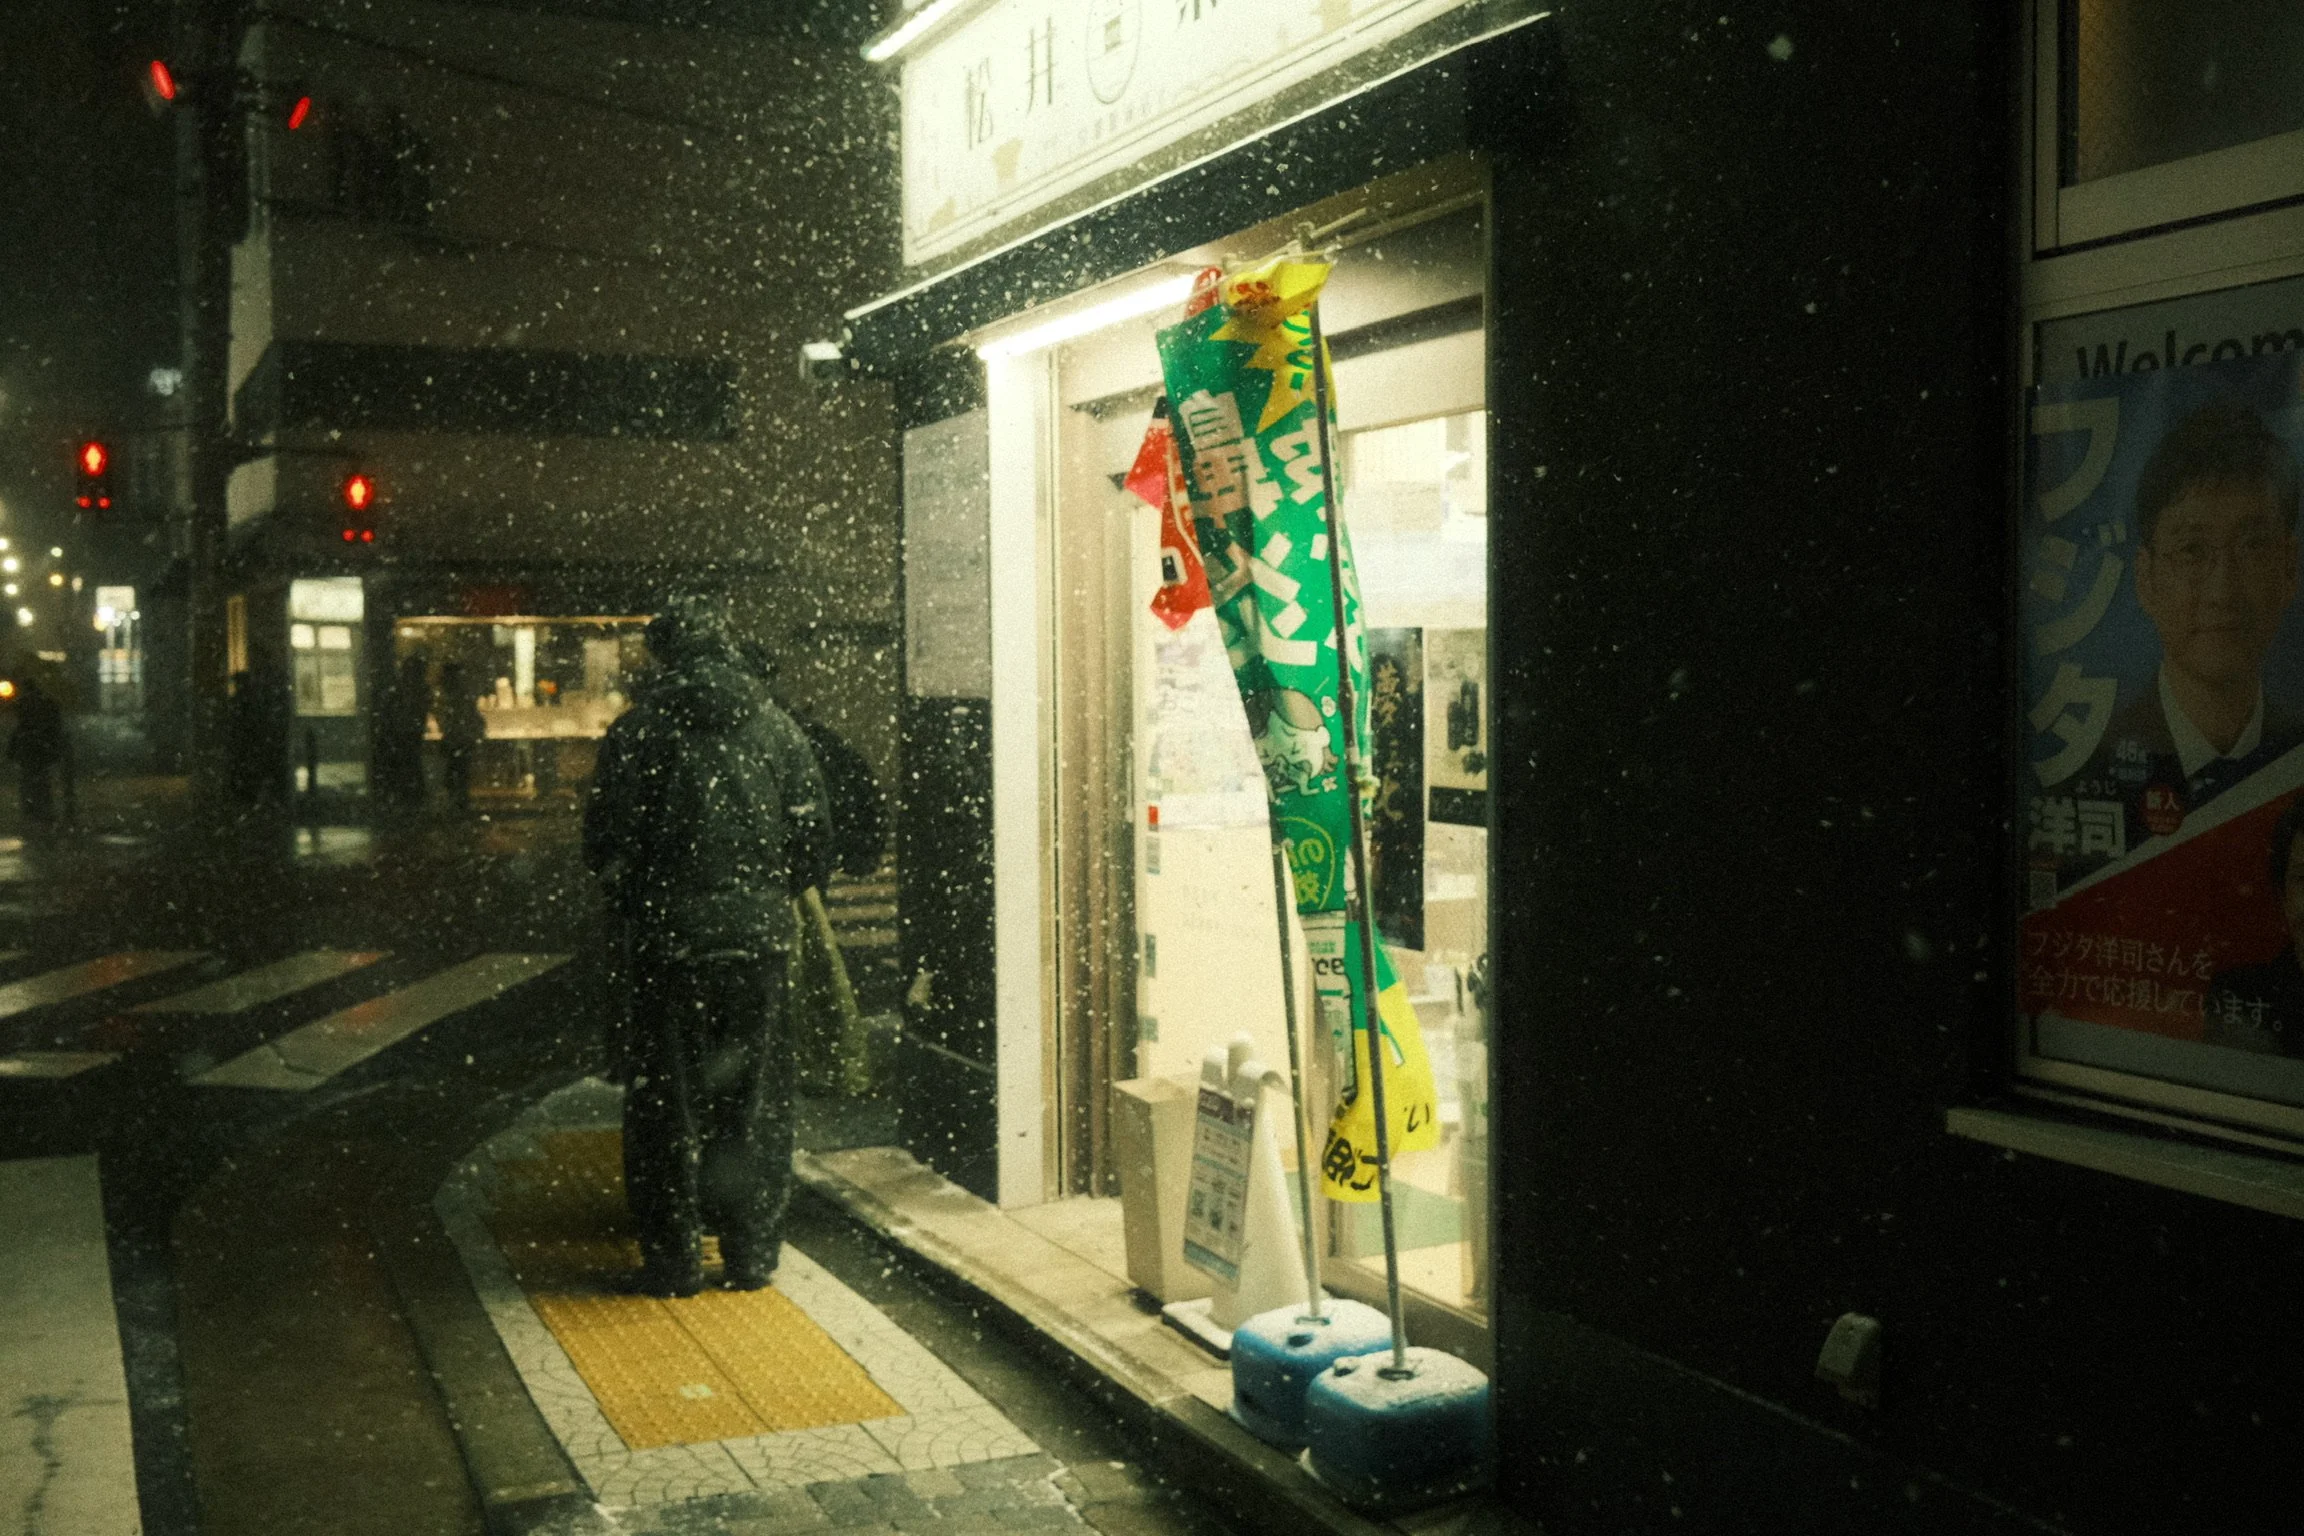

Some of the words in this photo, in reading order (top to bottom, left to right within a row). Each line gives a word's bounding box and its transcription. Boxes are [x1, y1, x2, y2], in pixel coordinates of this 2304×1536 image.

[2026, 396, 2126, 789] フジタ
[2075, 778, 2118, 796] ようじ
[2027, 796, 2126, 858] 洋司
[2026, 930, 2214, 982] フジタ洋司さんを
[2029, 963, 2284, 1033] 全力で応援しています。
